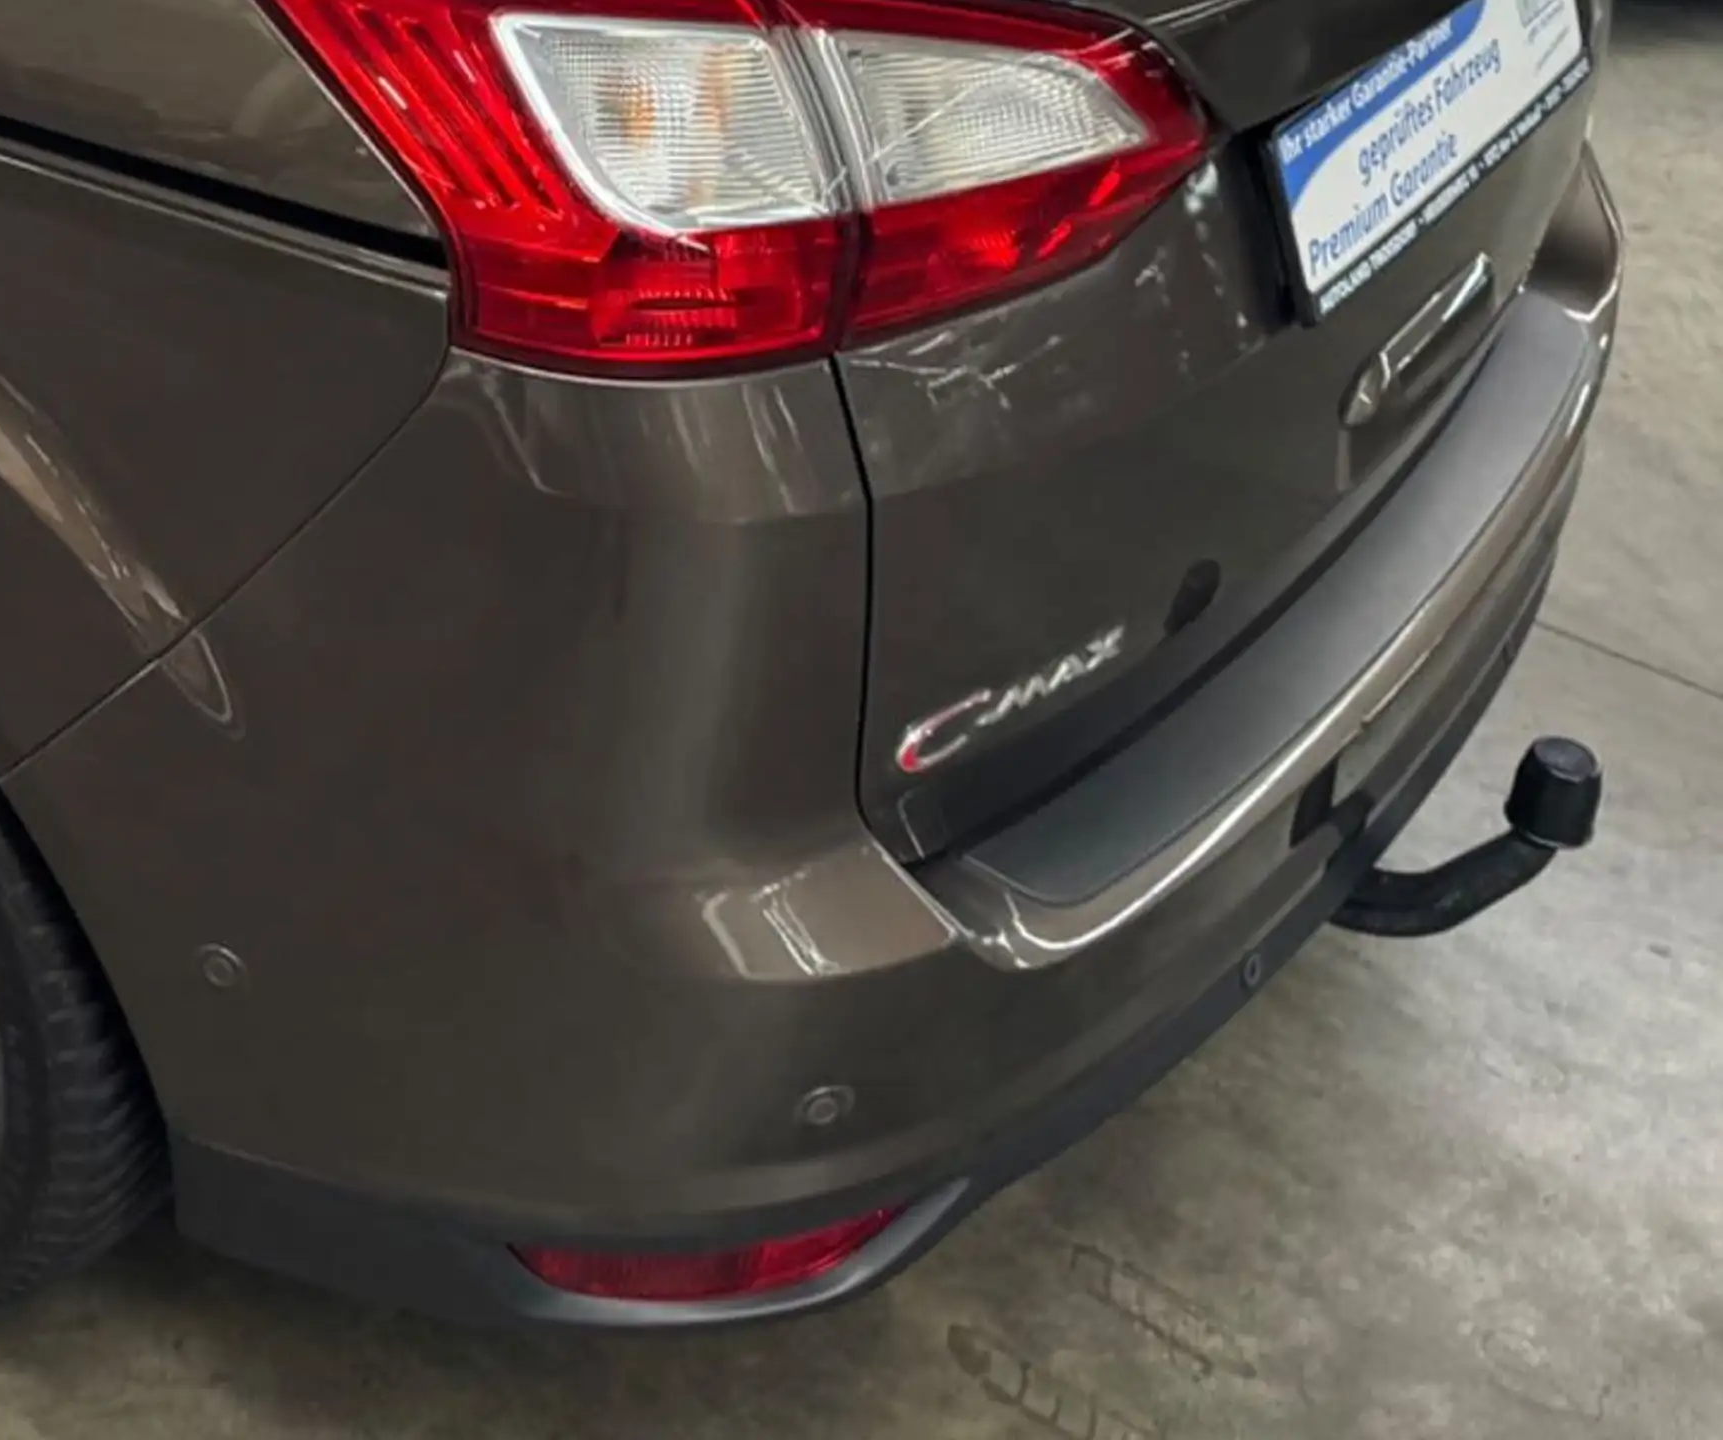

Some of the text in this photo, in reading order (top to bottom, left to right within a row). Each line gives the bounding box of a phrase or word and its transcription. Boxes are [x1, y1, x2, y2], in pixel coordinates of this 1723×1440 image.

[1302, 97, 1354, 150] starker
[1357, 94, 1435, 186] geprüftes
[1432, 38, 1502, 113] Fahrzeug
[1307, 189, 1390, 276] Premium
[1389, 128, 1459, 208] Garantie
